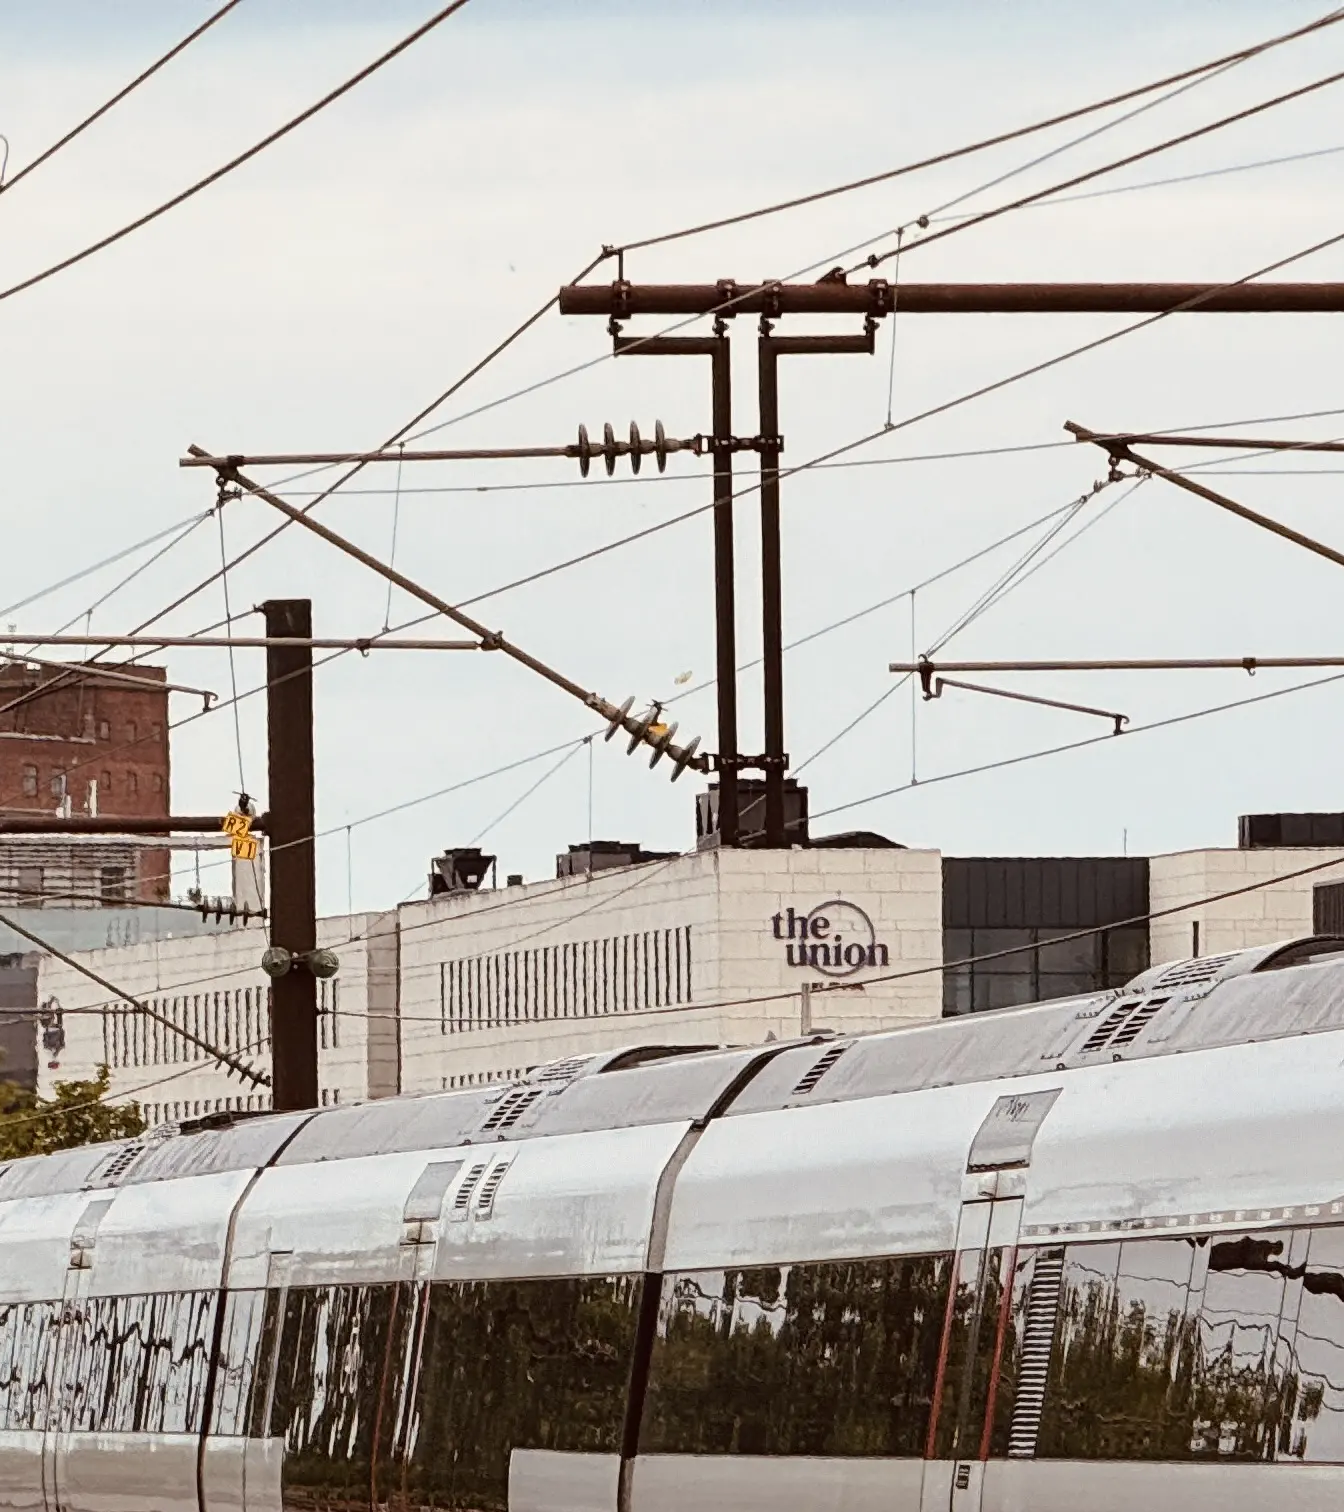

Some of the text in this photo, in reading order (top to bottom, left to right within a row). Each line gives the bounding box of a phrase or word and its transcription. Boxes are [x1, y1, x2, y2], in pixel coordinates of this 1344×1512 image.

[227, 816, 246, 837] R2
[236, 840, 253, 858] V1
[772, 908, 830, 940] the
[786, 934, 889, 967] union
